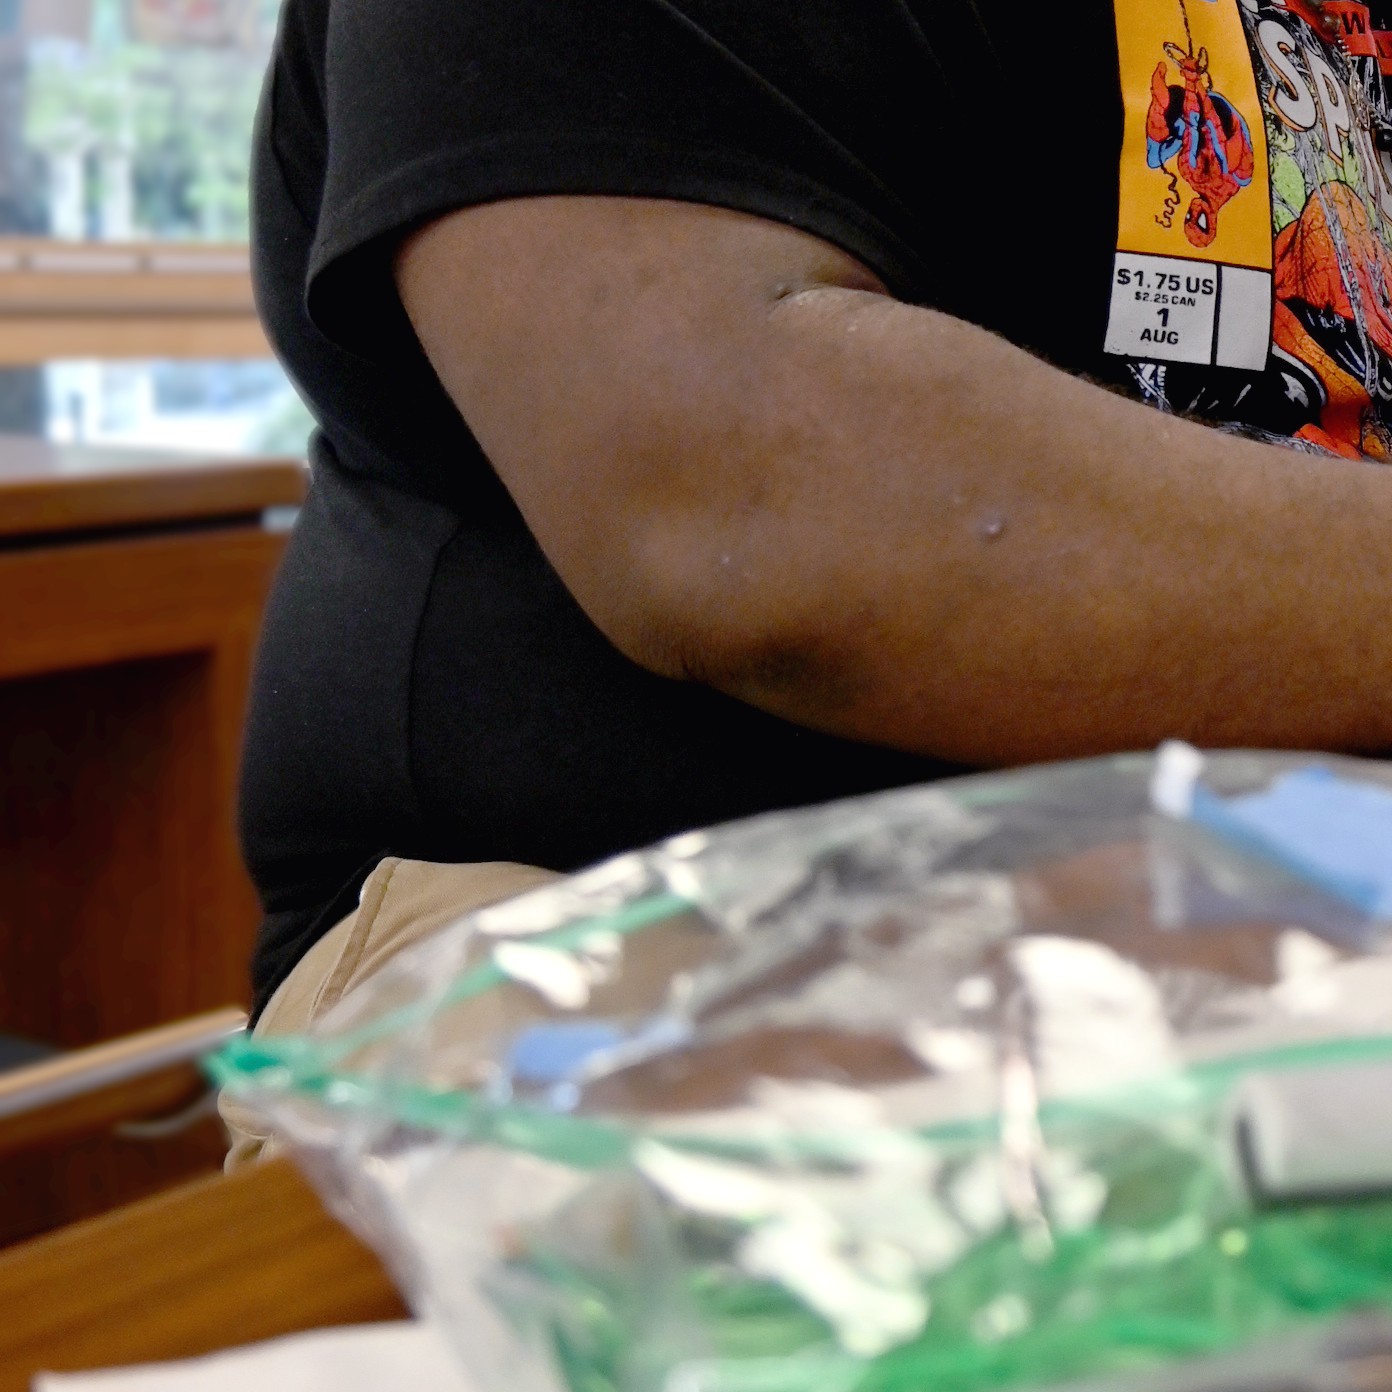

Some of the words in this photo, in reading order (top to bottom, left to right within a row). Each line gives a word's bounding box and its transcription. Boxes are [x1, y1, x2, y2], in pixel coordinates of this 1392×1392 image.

[1117, 268, 1180, 291] $1.75
[1185, 276, 1214, 295] US
[1134, 291, 1169, 304] $2.25
[1171, 296, 1196, 306] CAN
[1157, 308, 1169, 327] 1
[1140, 328, 1179, 345] AUG
